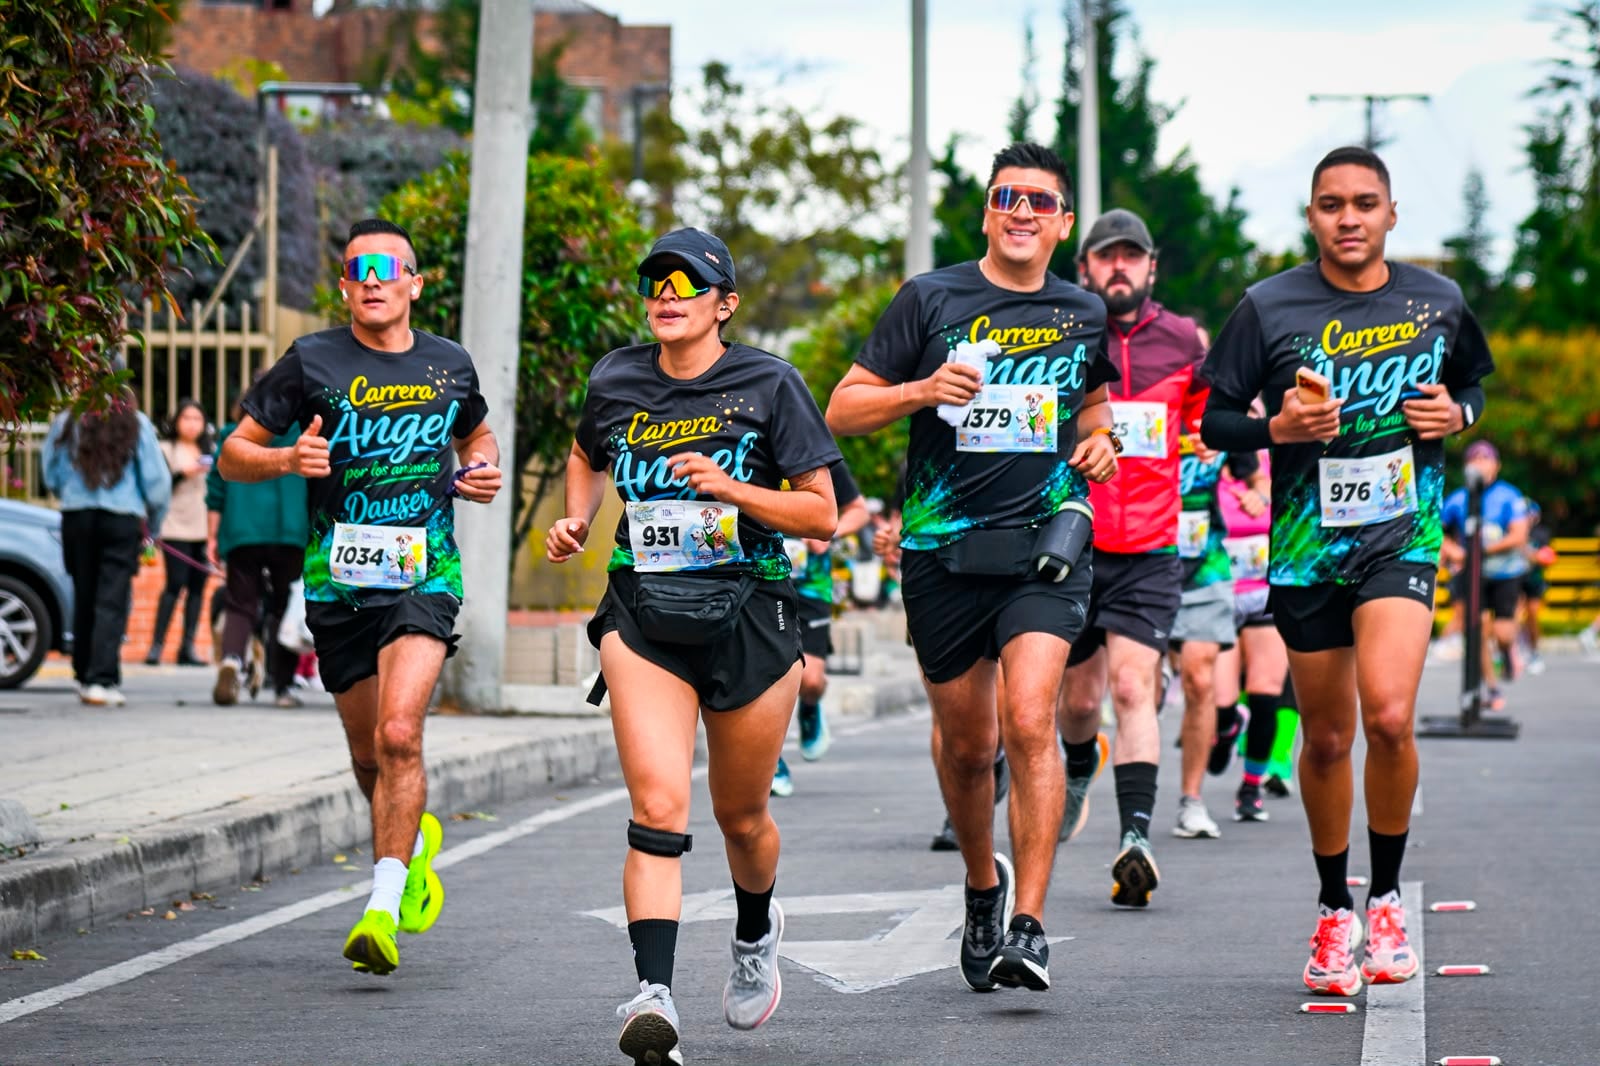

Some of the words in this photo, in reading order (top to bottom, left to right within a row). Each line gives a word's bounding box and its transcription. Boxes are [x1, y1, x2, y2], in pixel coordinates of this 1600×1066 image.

[969, 315, 1063, 345] Carrera
[1321, 319, 1421, 356] Carrera
[350, 375, 437, 407] Carrera
[626, 411, 723, 445] Carrera
[343, 467, 369, 487] por
[370, 459, 388, 476] los
[390, 457, 441, 476] animales
[343, 489, 435, 525] Dauser
[1329, 481, 1372, 503] 976
[642, 525, 680, 547] 931
[334, 545, 385, 567] 1034
